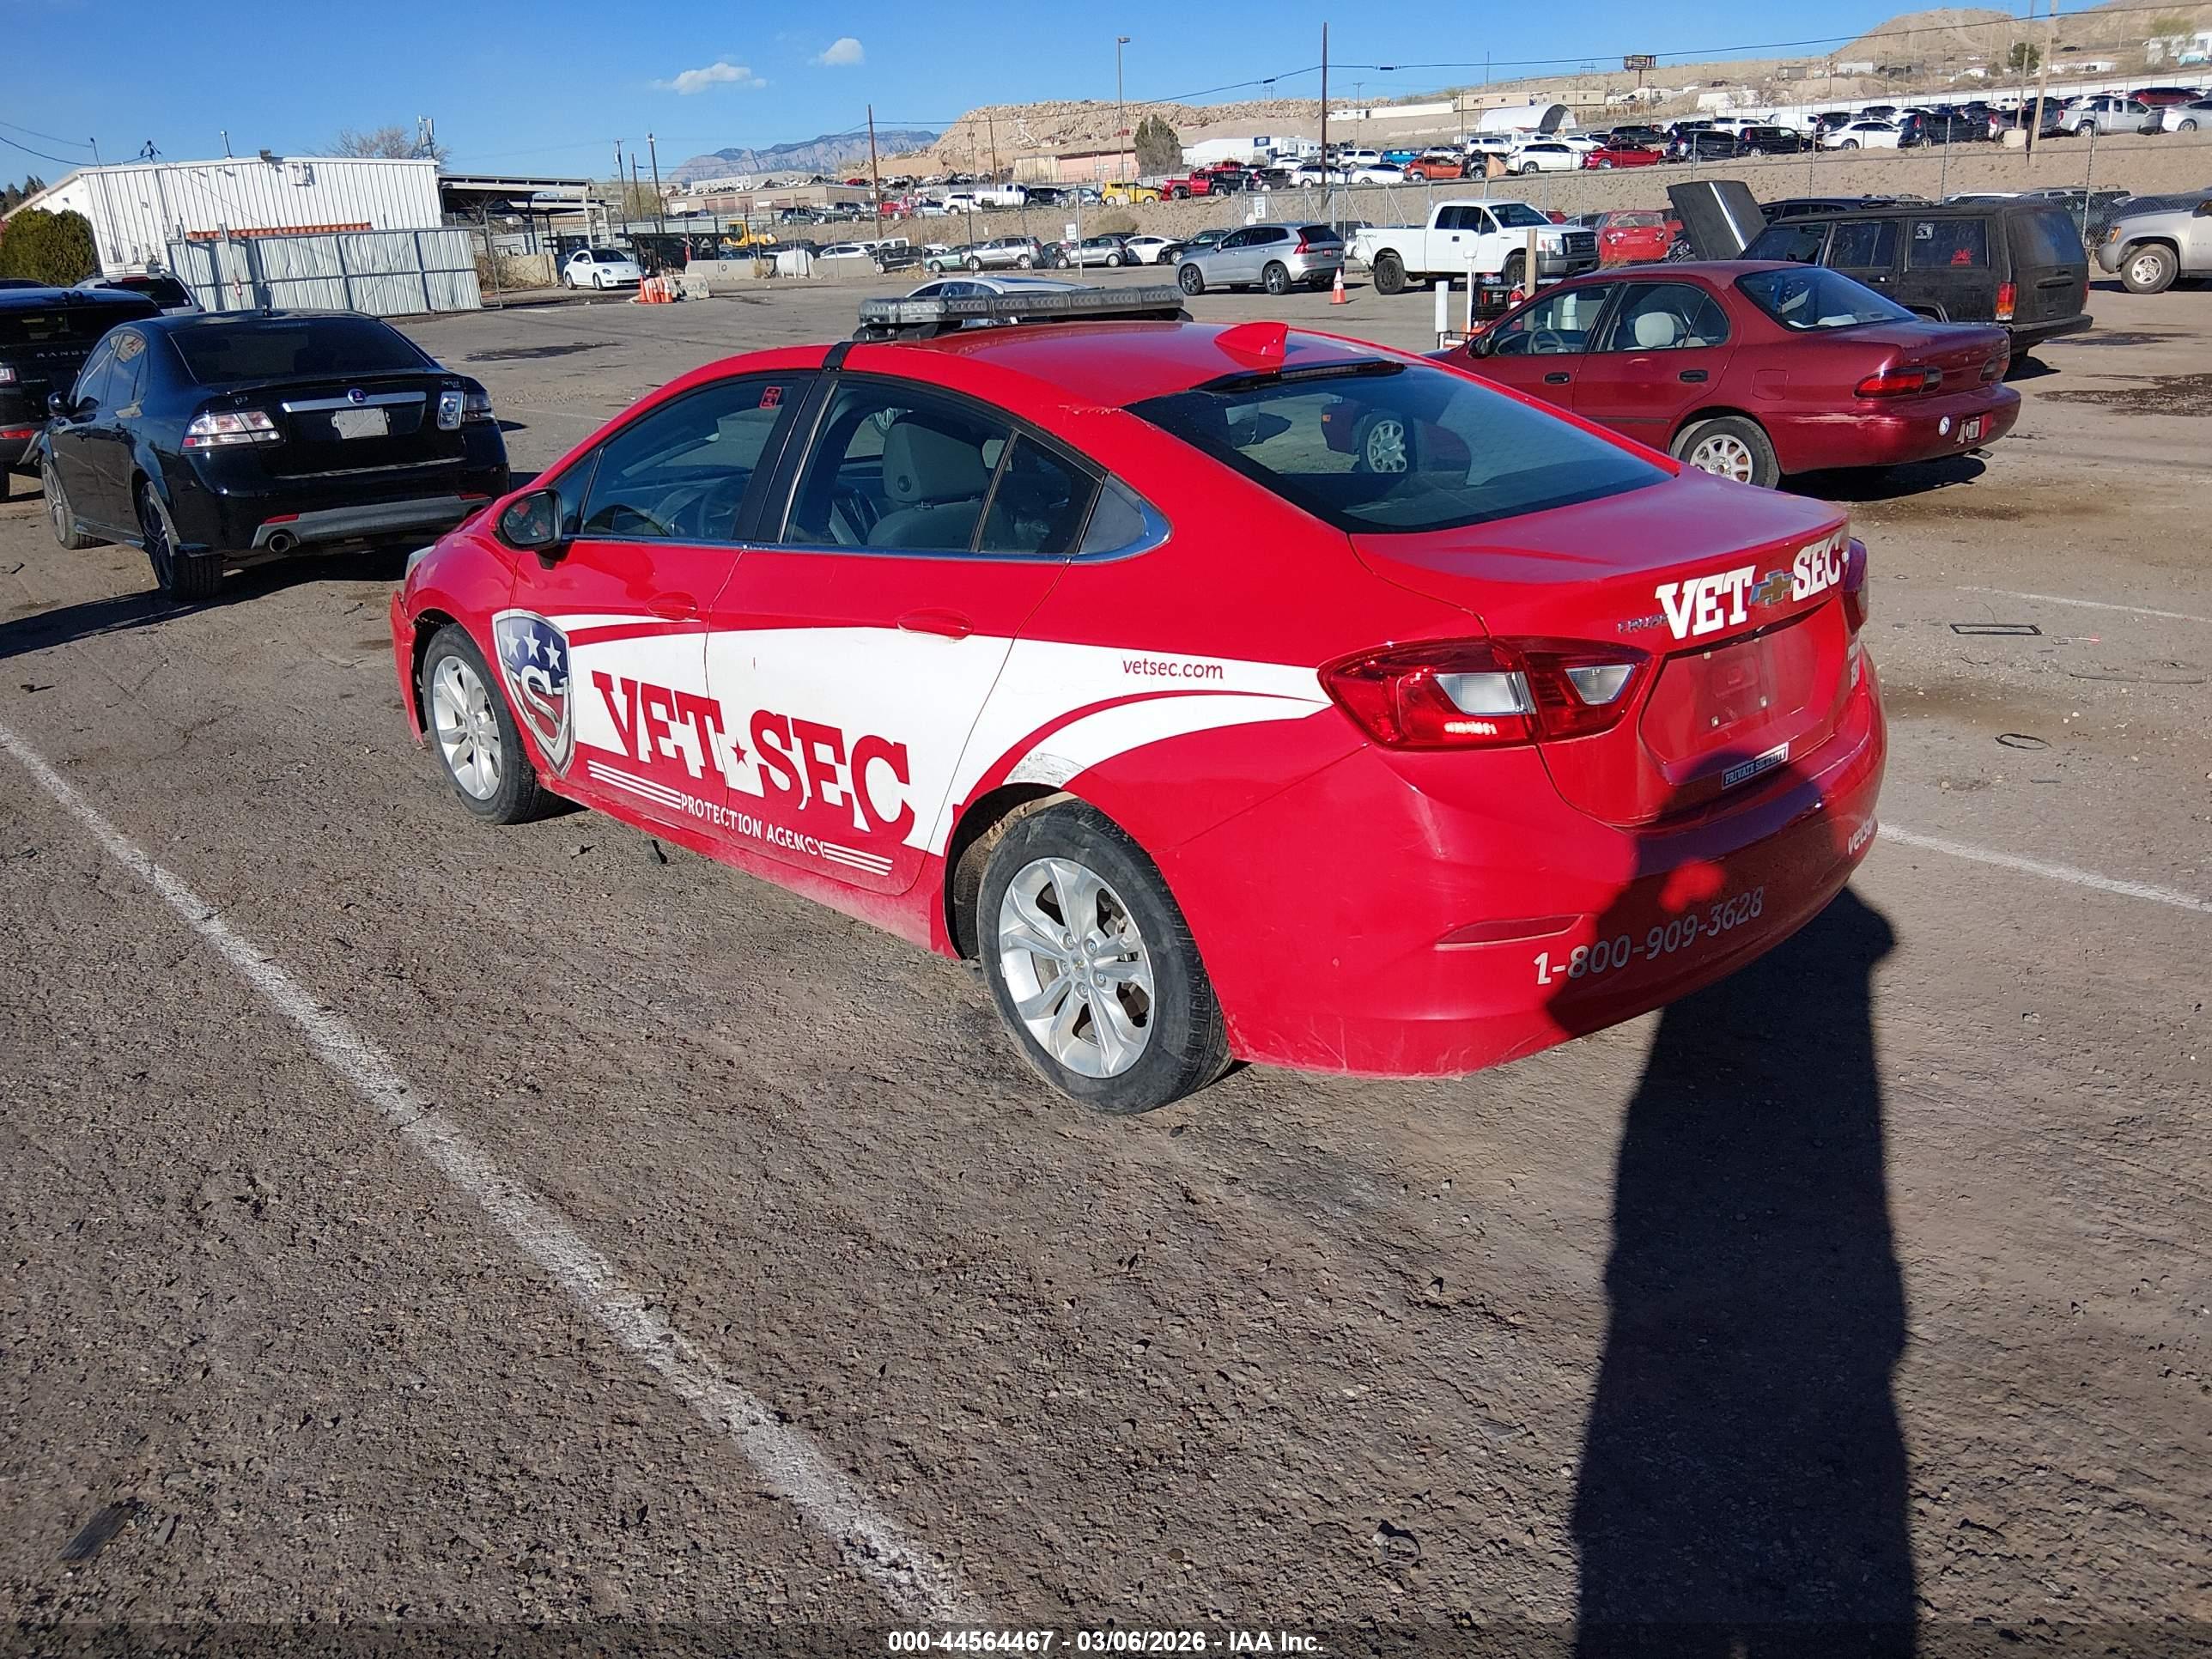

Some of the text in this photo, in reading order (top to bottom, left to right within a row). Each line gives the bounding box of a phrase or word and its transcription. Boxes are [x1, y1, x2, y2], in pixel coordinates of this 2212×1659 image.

[1655, 530, 1843, 640] VET SEC
[1123, 658, 1224, 679] vetsec.com
[591, 670, 916, 843] VET SEC
[1724, 763, 1754, 785] PRIVATE
[681, 793, 827, 859] PROTECTION AGENCY
[1533, 885, 1765, 986] 1-800-909-3628
